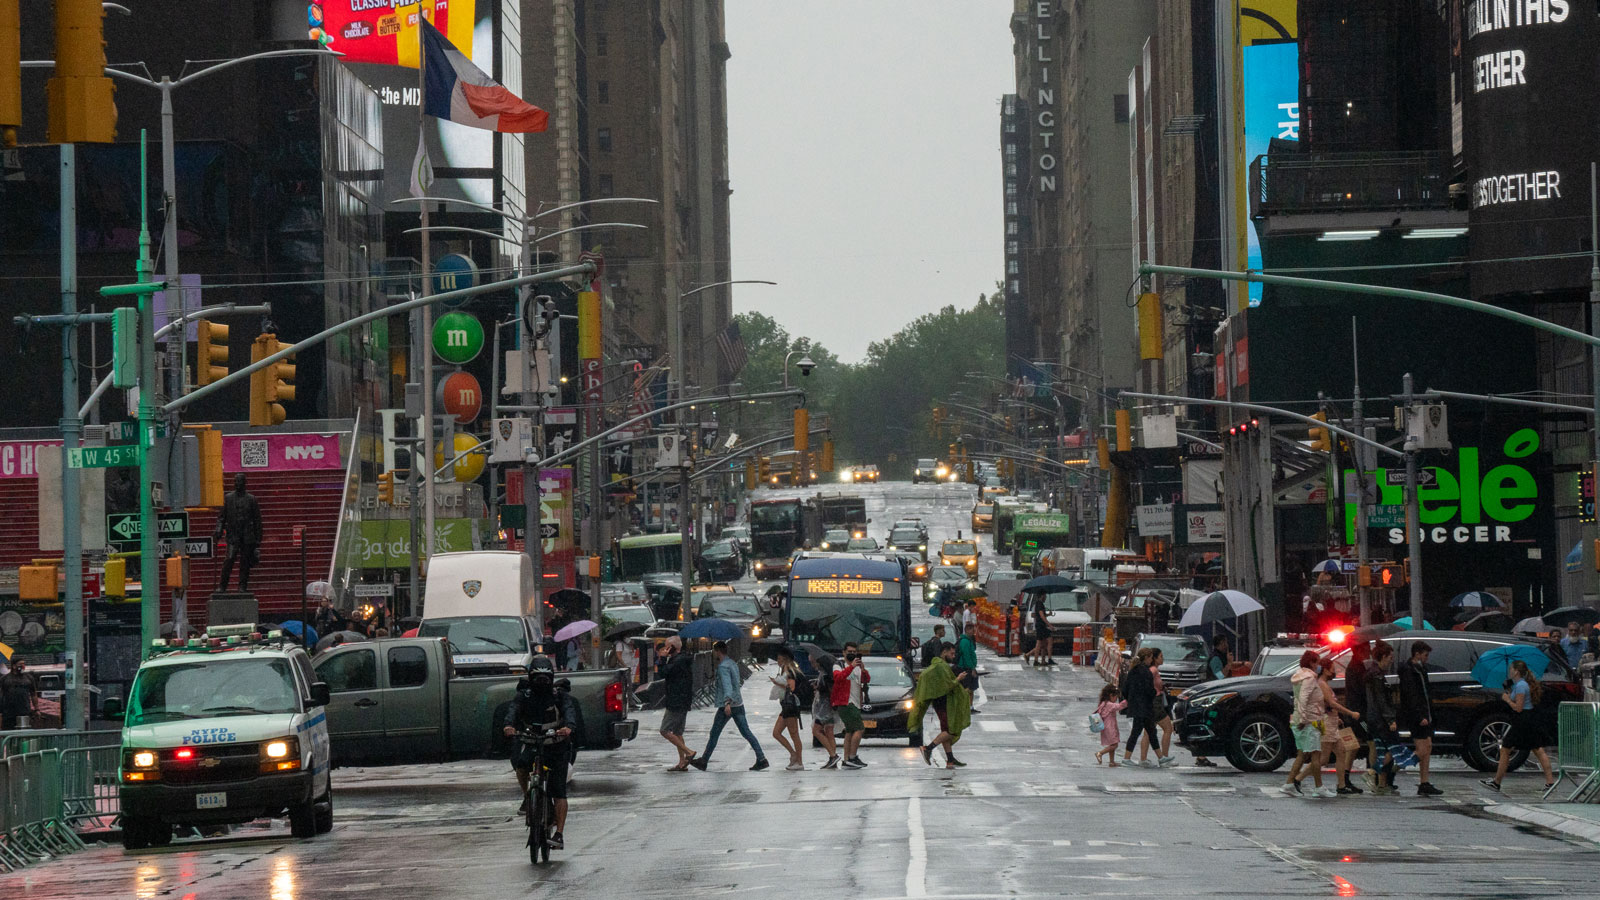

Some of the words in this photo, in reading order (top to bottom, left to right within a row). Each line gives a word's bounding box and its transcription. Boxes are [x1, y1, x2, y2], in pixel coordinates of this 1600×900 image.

[344, 26, 370, 39] CHOCOLATE
[379, 22, 401, 35] BUTTER
[381, 86, 400, 105] the
[440, 271, 457, 290] m
[447, 329, 468, 347] m
[459, 389, 475, 406] m
[85, 451, 98, 465] W
[104, 449, 121, 464] 45
[285, 445, 325, 460] NYC
[1387, 506, 1397, 514] 46
[121, 523, 141, 533] ONE
[1023, 518, 1061, 527] LEGALIZE
[1388, 526, 1511, 545] SCCER
[808, 579, 838, 593] MASKS
[838, 580, 884, 595] REQUIRED
[182, 733, 237, 745] POLICE
[191, 727, 229, 736] NYPD
